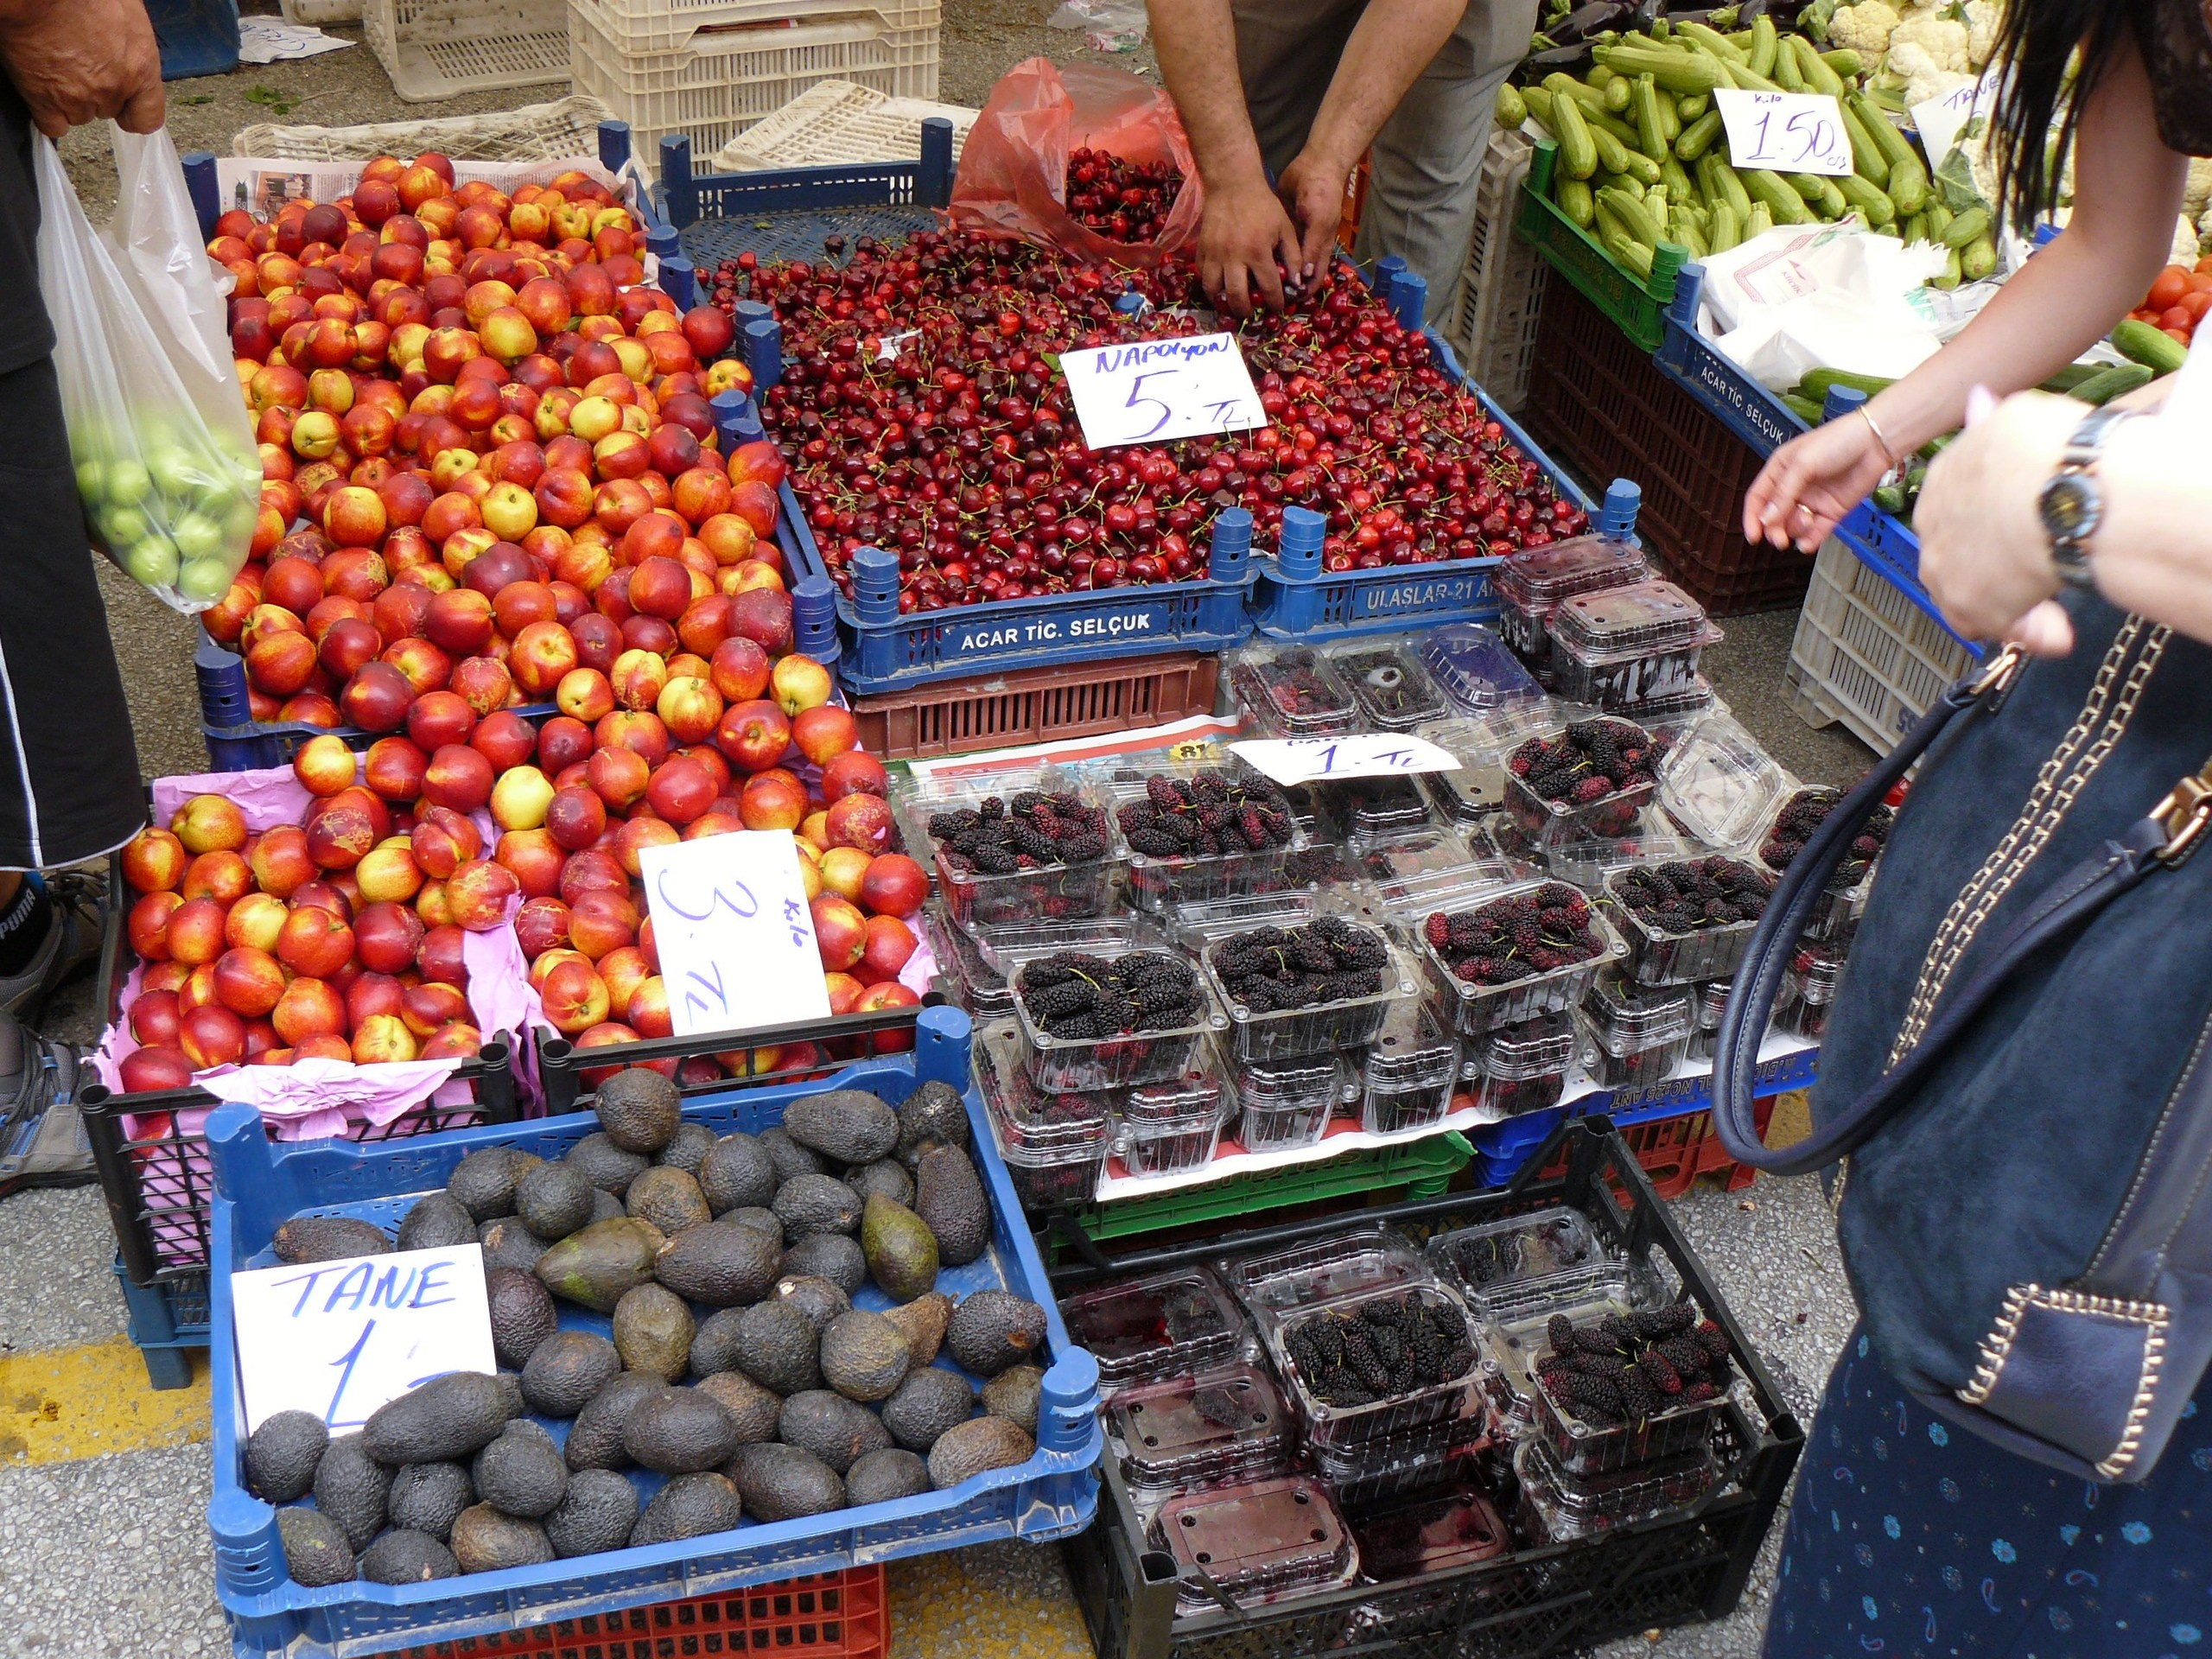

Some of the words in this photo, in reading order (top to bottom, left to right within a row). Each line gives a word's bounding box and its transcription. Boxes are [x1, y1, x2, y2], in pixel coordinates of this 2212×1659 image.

[1700, 365, 1726, 395] ACAR
[1745, 404, 1784, 445] SELÇUK
[961, 628, 1018, 651] ACAR
[1070, 613, 1151, 636] SELÇUK
[0, 887, 35, 940] PUMA
[270, 1262, 456, 1318] TANE
